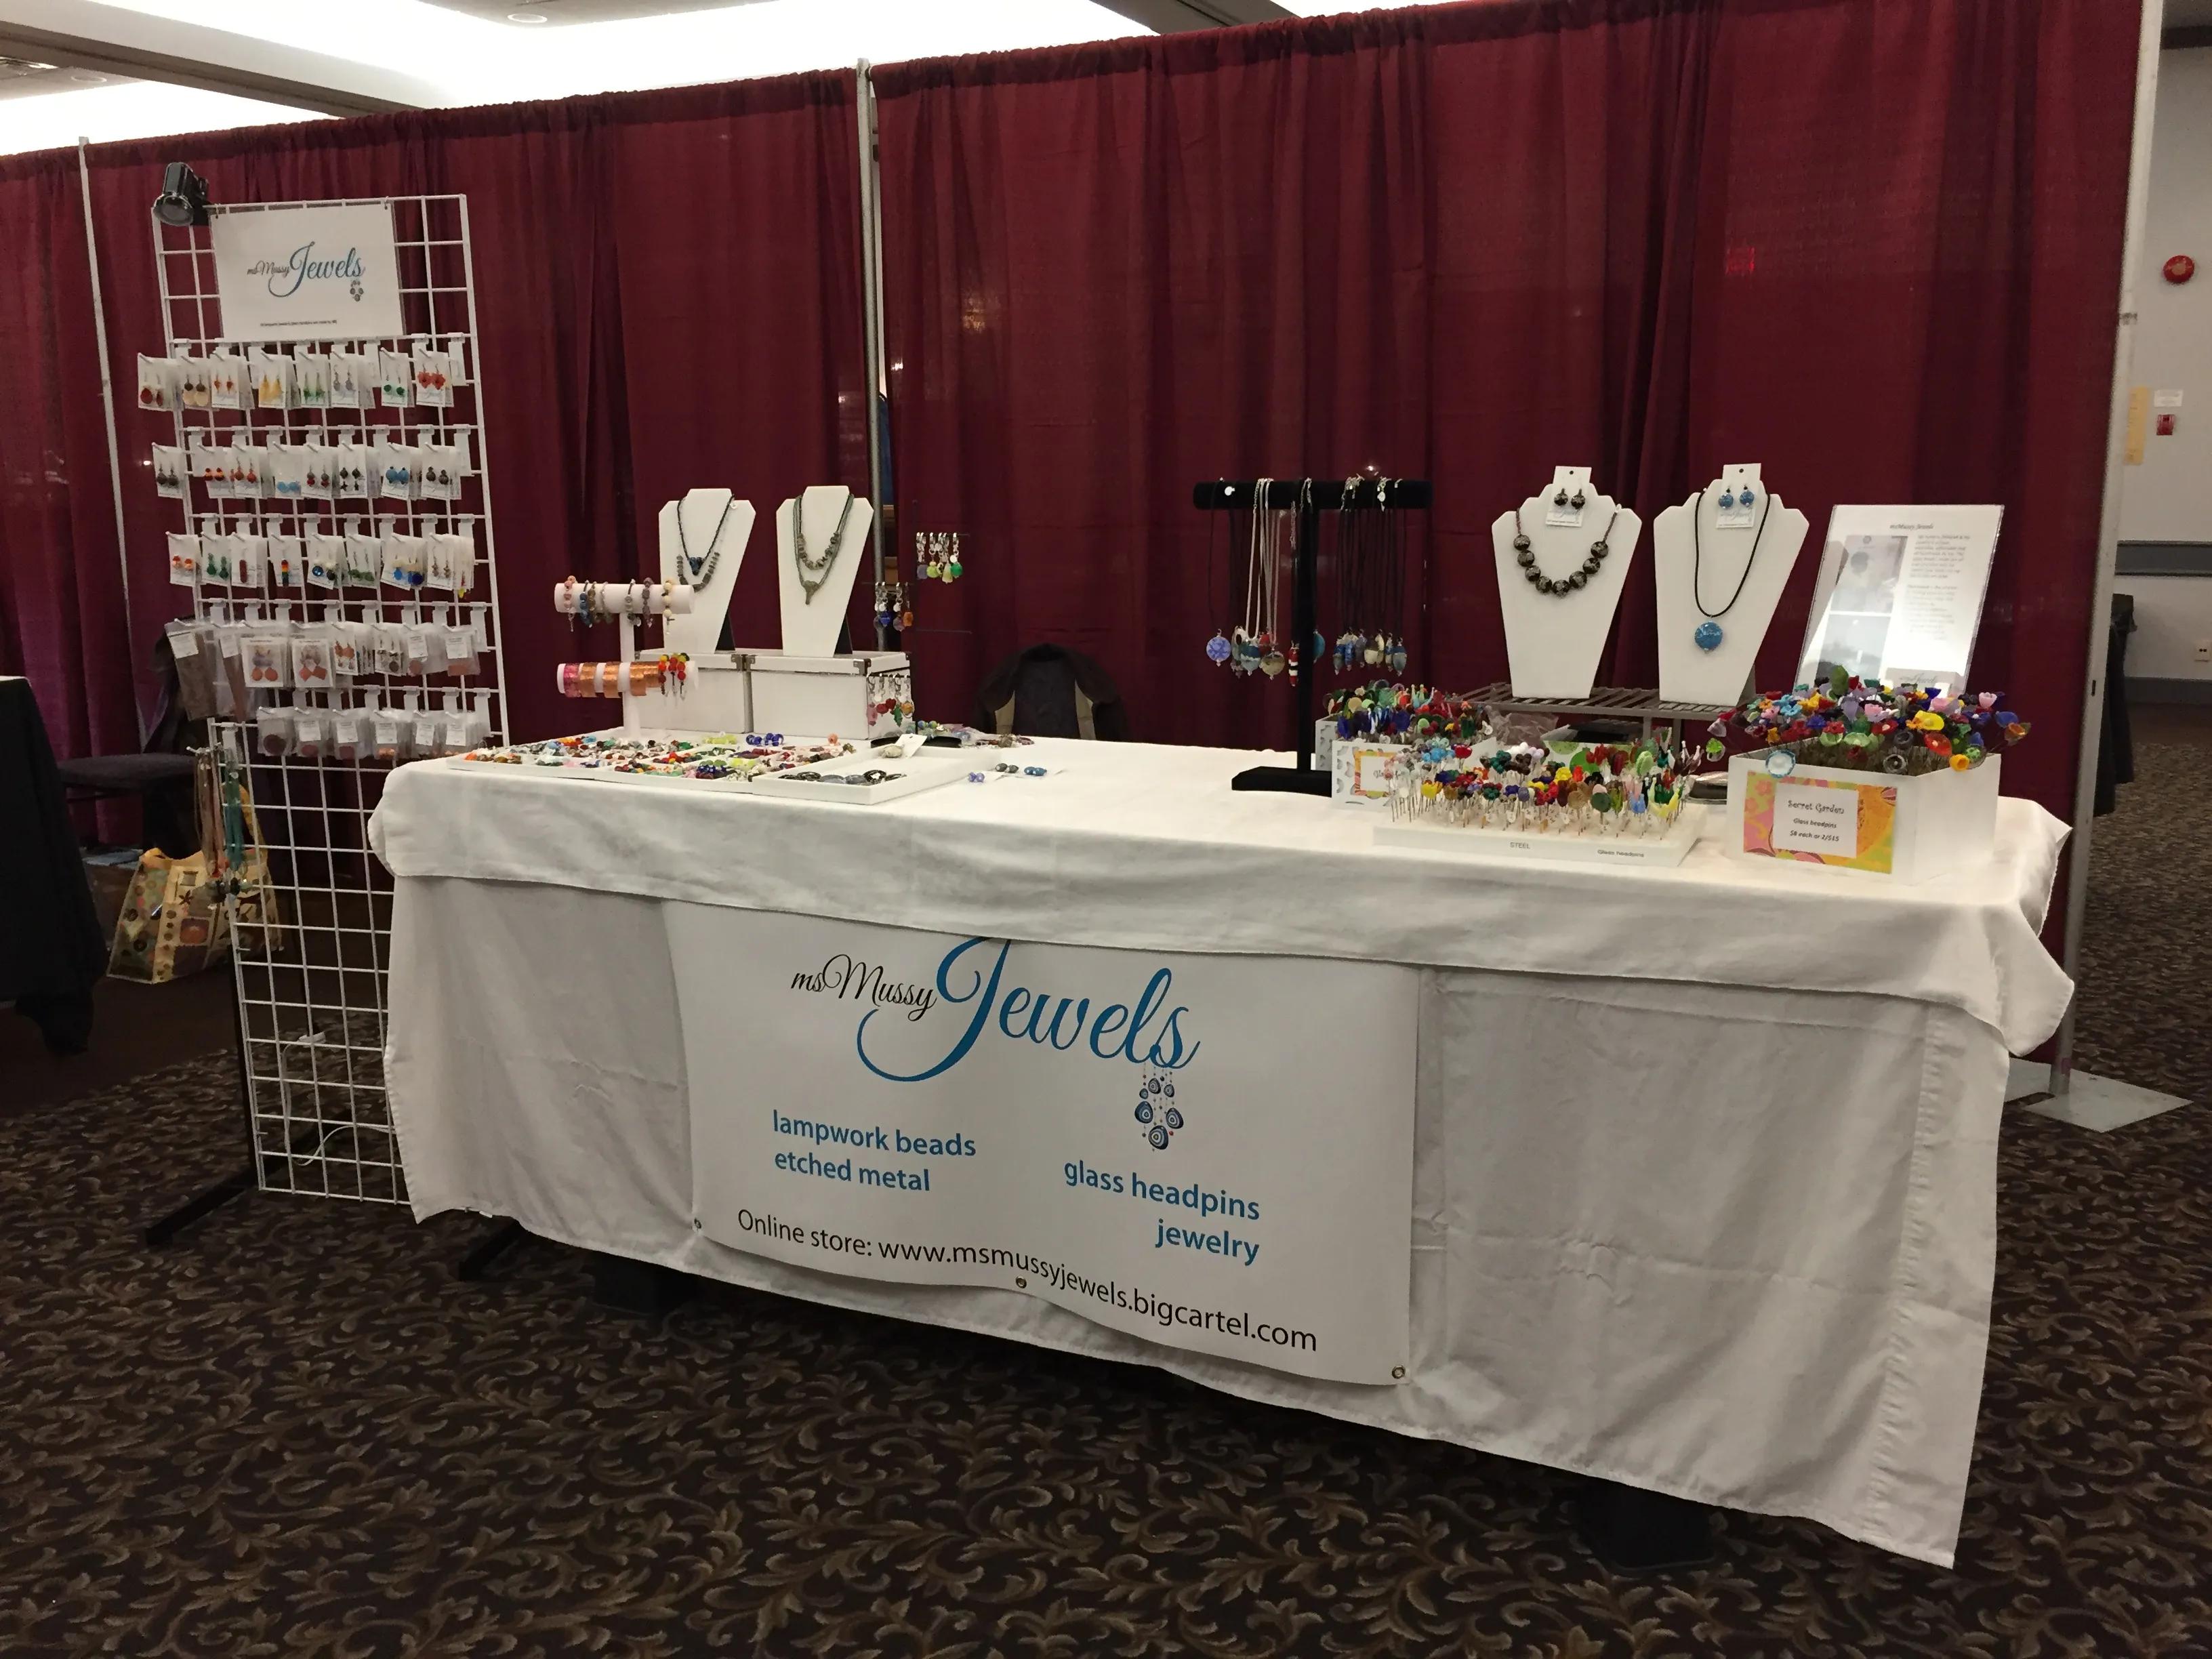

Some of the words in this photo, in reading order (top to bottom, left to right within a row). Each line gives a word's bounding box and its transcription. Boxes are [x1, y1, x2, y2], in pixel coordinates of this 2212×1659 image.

[268, 241, 366, 298] Jewels
[1788, 800, 1813, 811] Secret
[1815, 803, 1845, 815] Garden
[1793, 817, 1809, 825] Glass
[1509, 841, 1531, 850] STEEL
[857, 937, 1200, 1082] Jewels
[773, 1109, 889, 1151] lampwork
[895, 1128, 977, 1156] beads
[775, 1152, 852, 1182] etched
[859, 1168, 930, 1191] metal
[1064, 1160, 1124, 1193] glass
[1132, 1172, 1260, 1221] headpins
[1155, 1218, 1260, 1267] jewelry
[737, 1209, 805, 1245] Online
[811, 1228, 873, 1257] store:
[878, 1240, 1317, 1352] www.msmussyjewels.bigcartel.com
